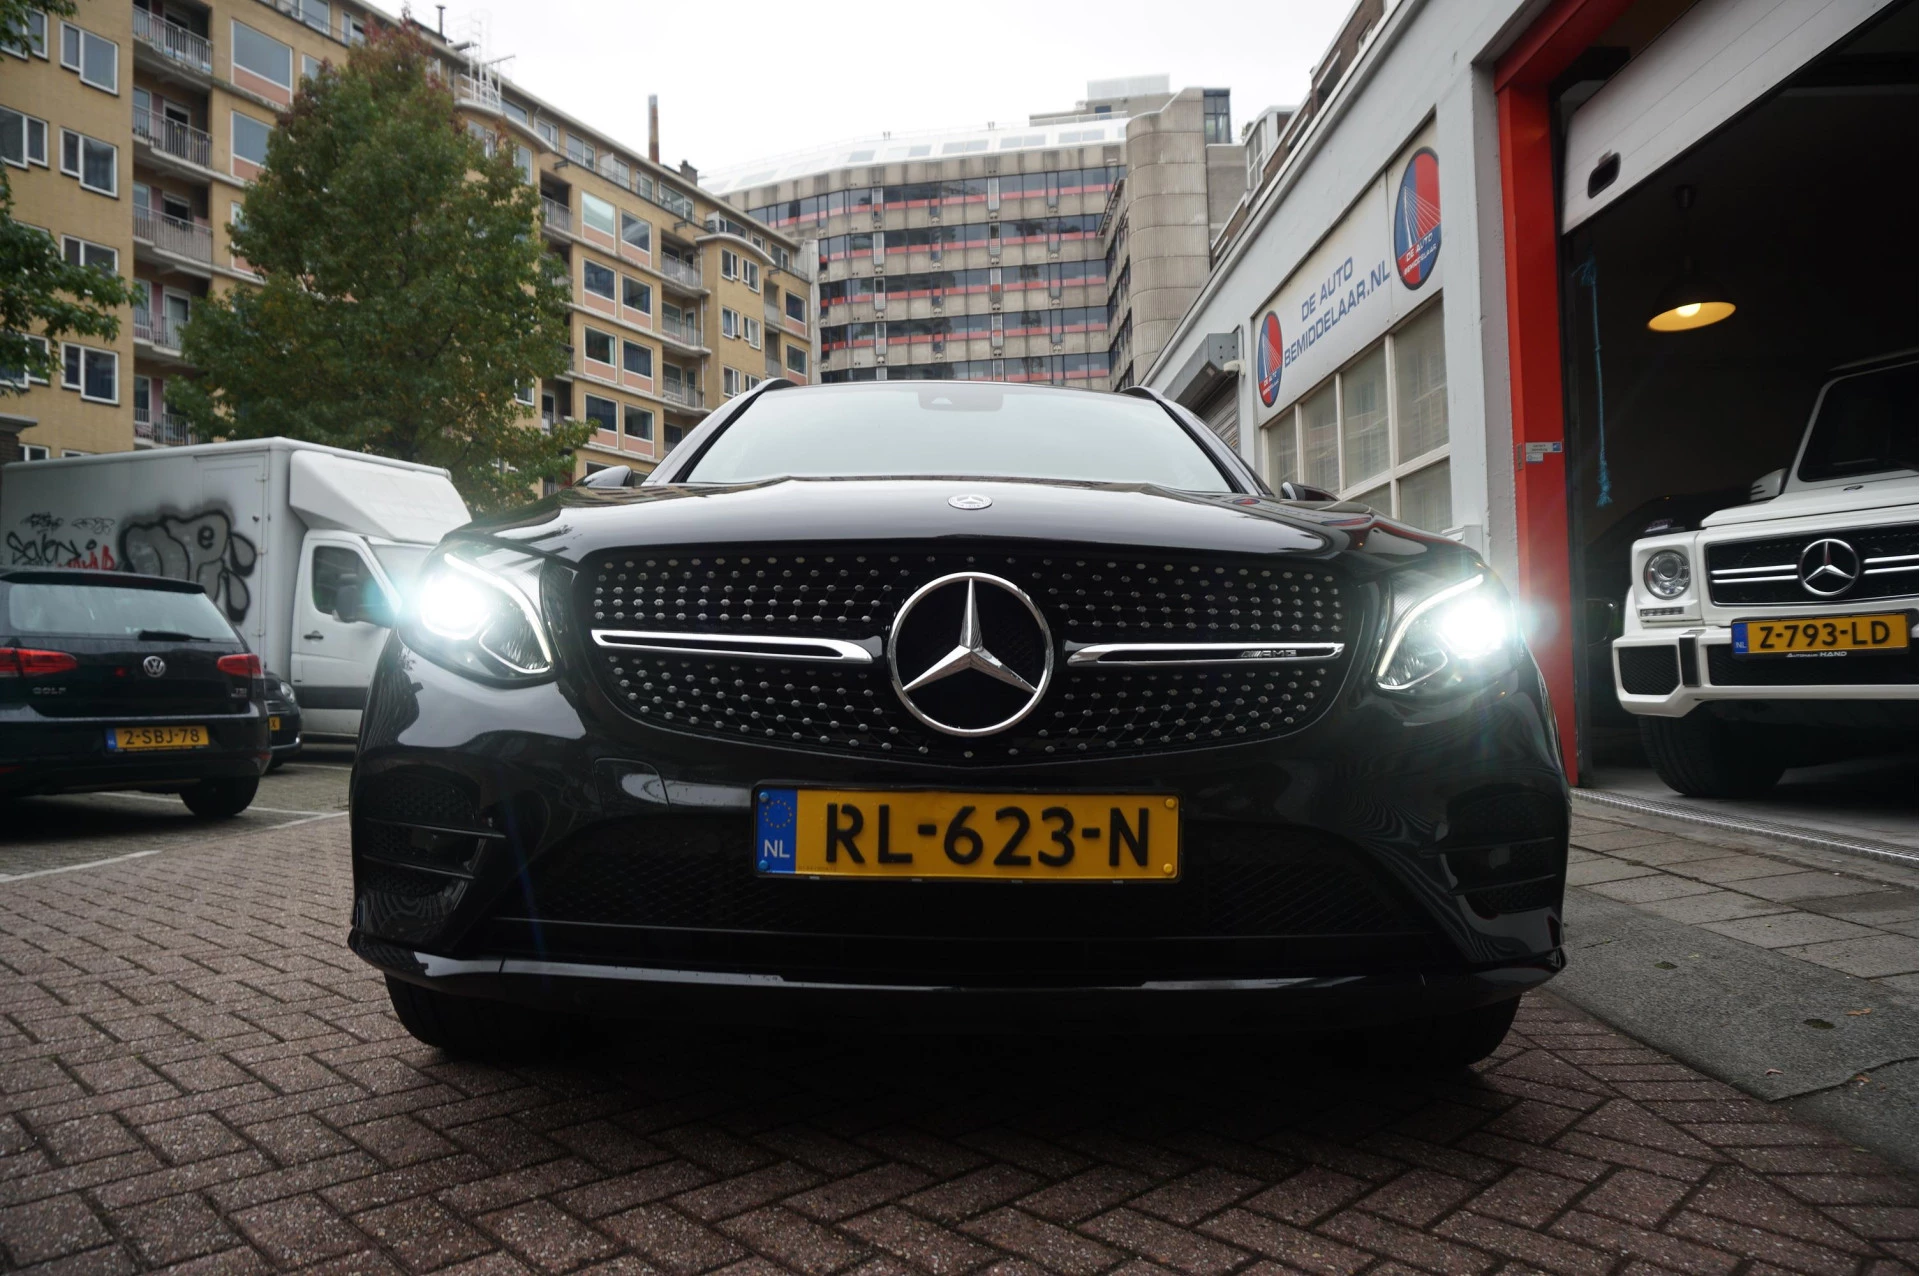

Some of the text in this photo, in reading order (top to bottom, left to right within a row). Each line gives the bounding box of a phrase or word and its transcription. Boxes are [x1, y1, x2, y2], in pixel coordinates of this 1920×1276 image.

[1406, 232, 1433, 262] DE AUTO
[1301, 256, 1353, 322] DE AUTO
[1284, 260, 1390, 368] BEMIDDELAAR.NL
[1735, 641, 1746, 649] NL
[1759, 620, 1891, 649] Z-793-LD
[124, 728, 200, 745] 2-SBJ-78
[763, 839, 790, 859] NL
[825, 802, 1150, 867] RL-623-N
